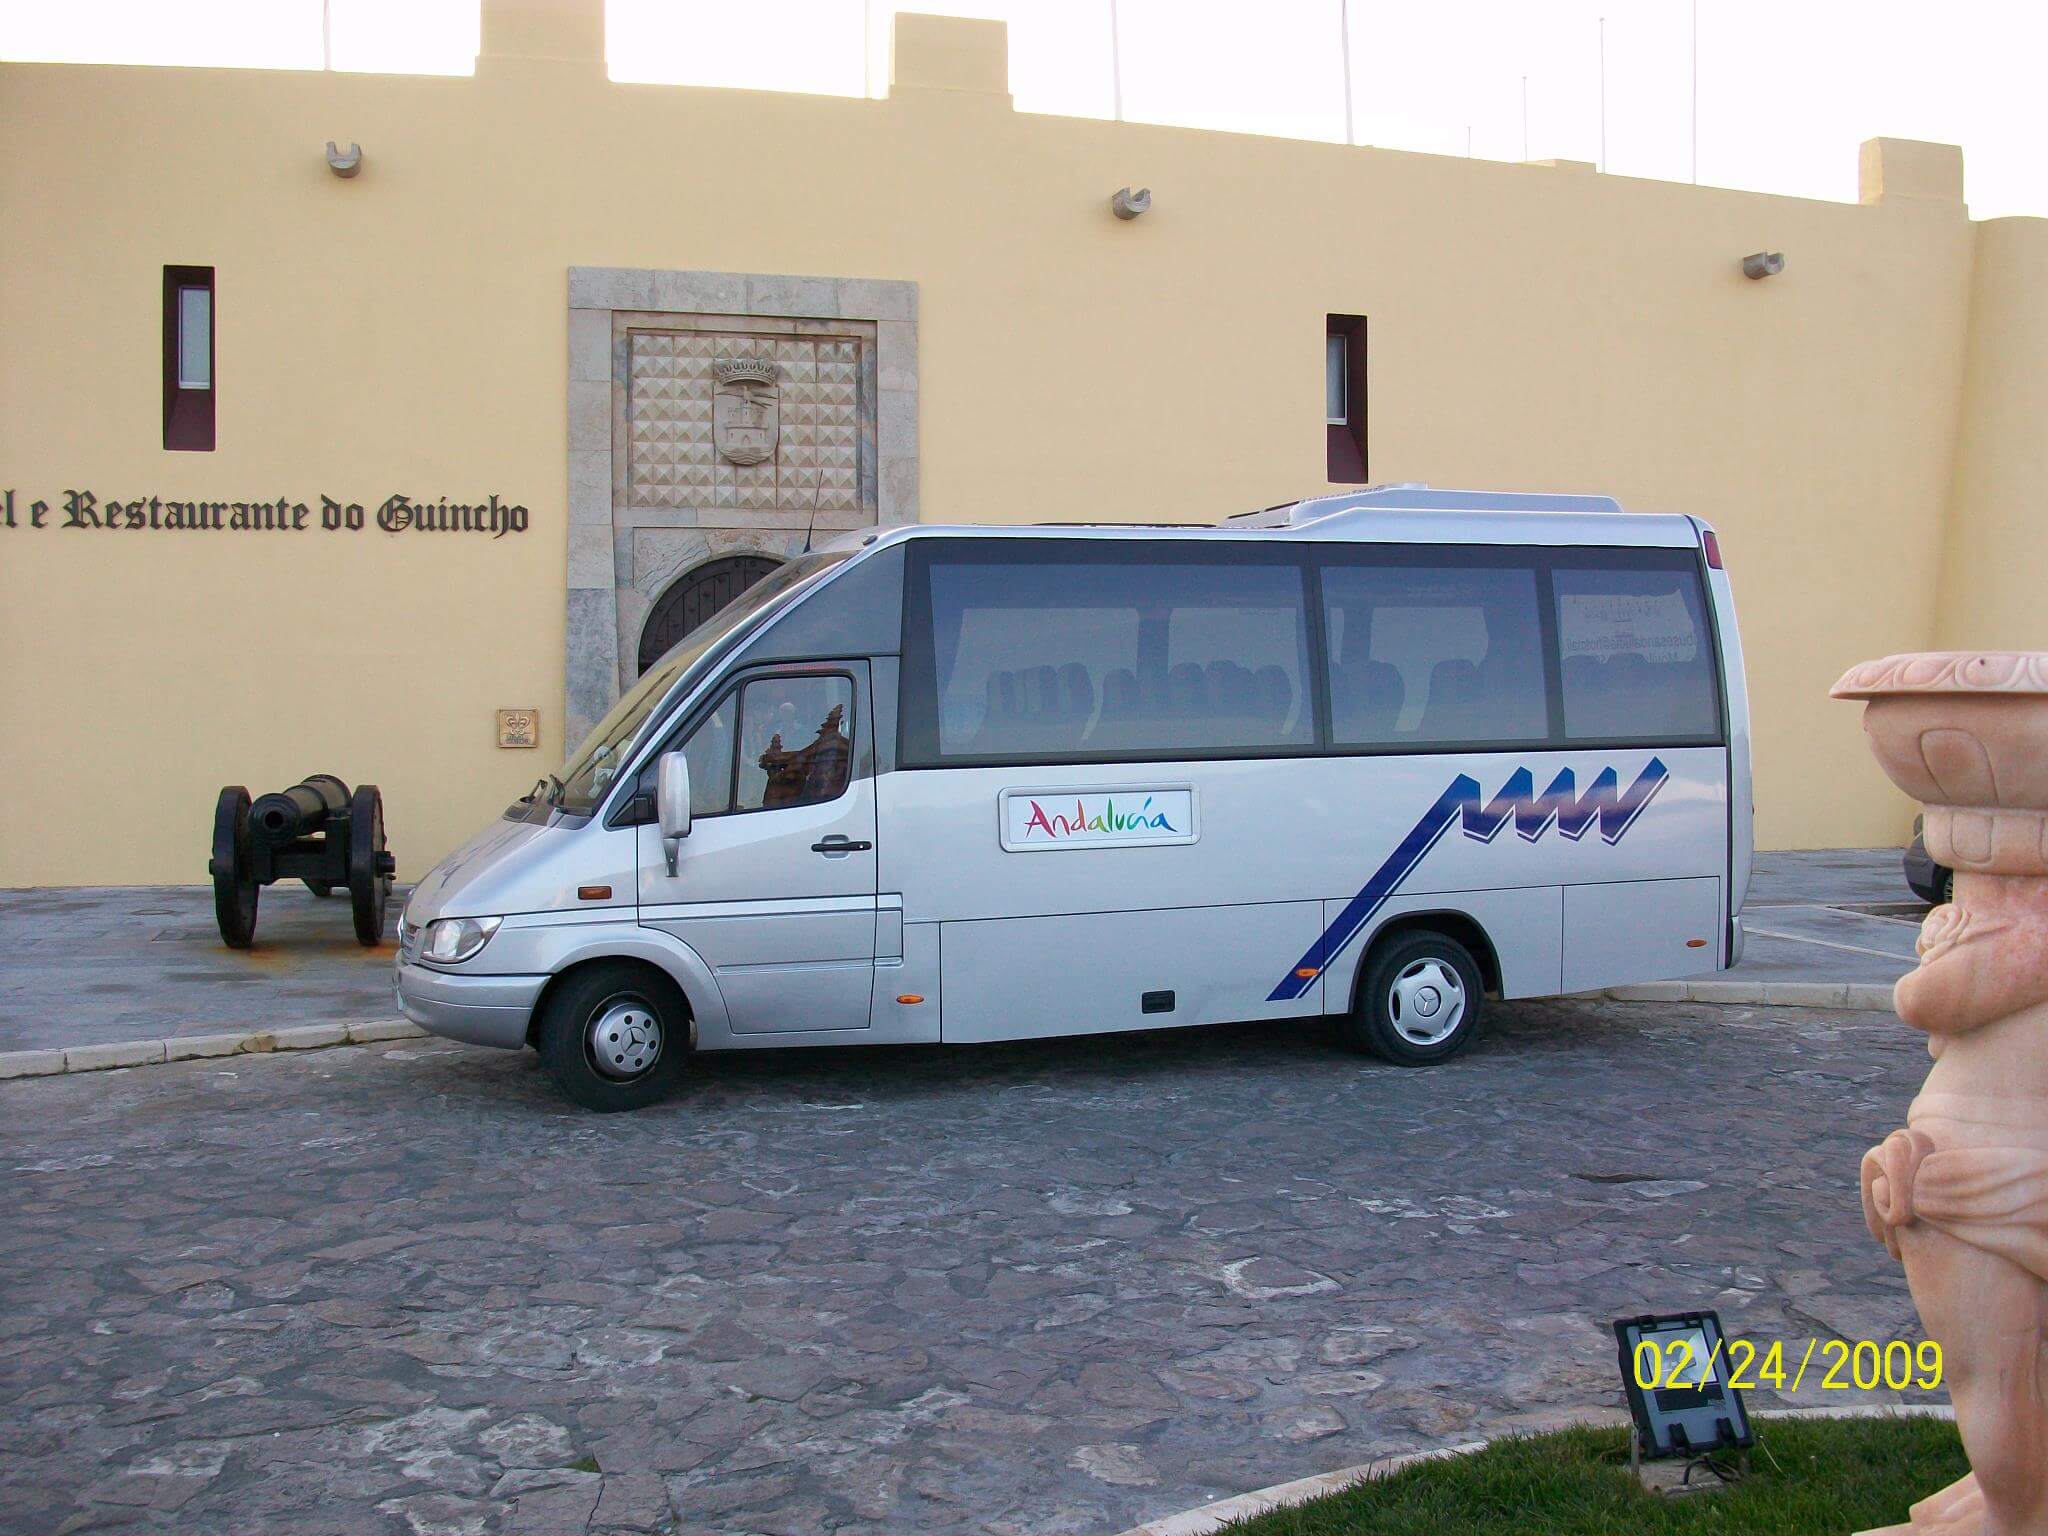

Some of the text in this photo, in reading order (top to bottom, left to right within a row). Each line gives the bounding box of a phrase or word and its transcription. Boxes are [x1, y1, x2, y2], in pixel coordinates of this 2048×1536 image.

[0, 489, 529, 539] l e Restaurante do Guincho
[1024, 796, 1178, 838] Andalucía
